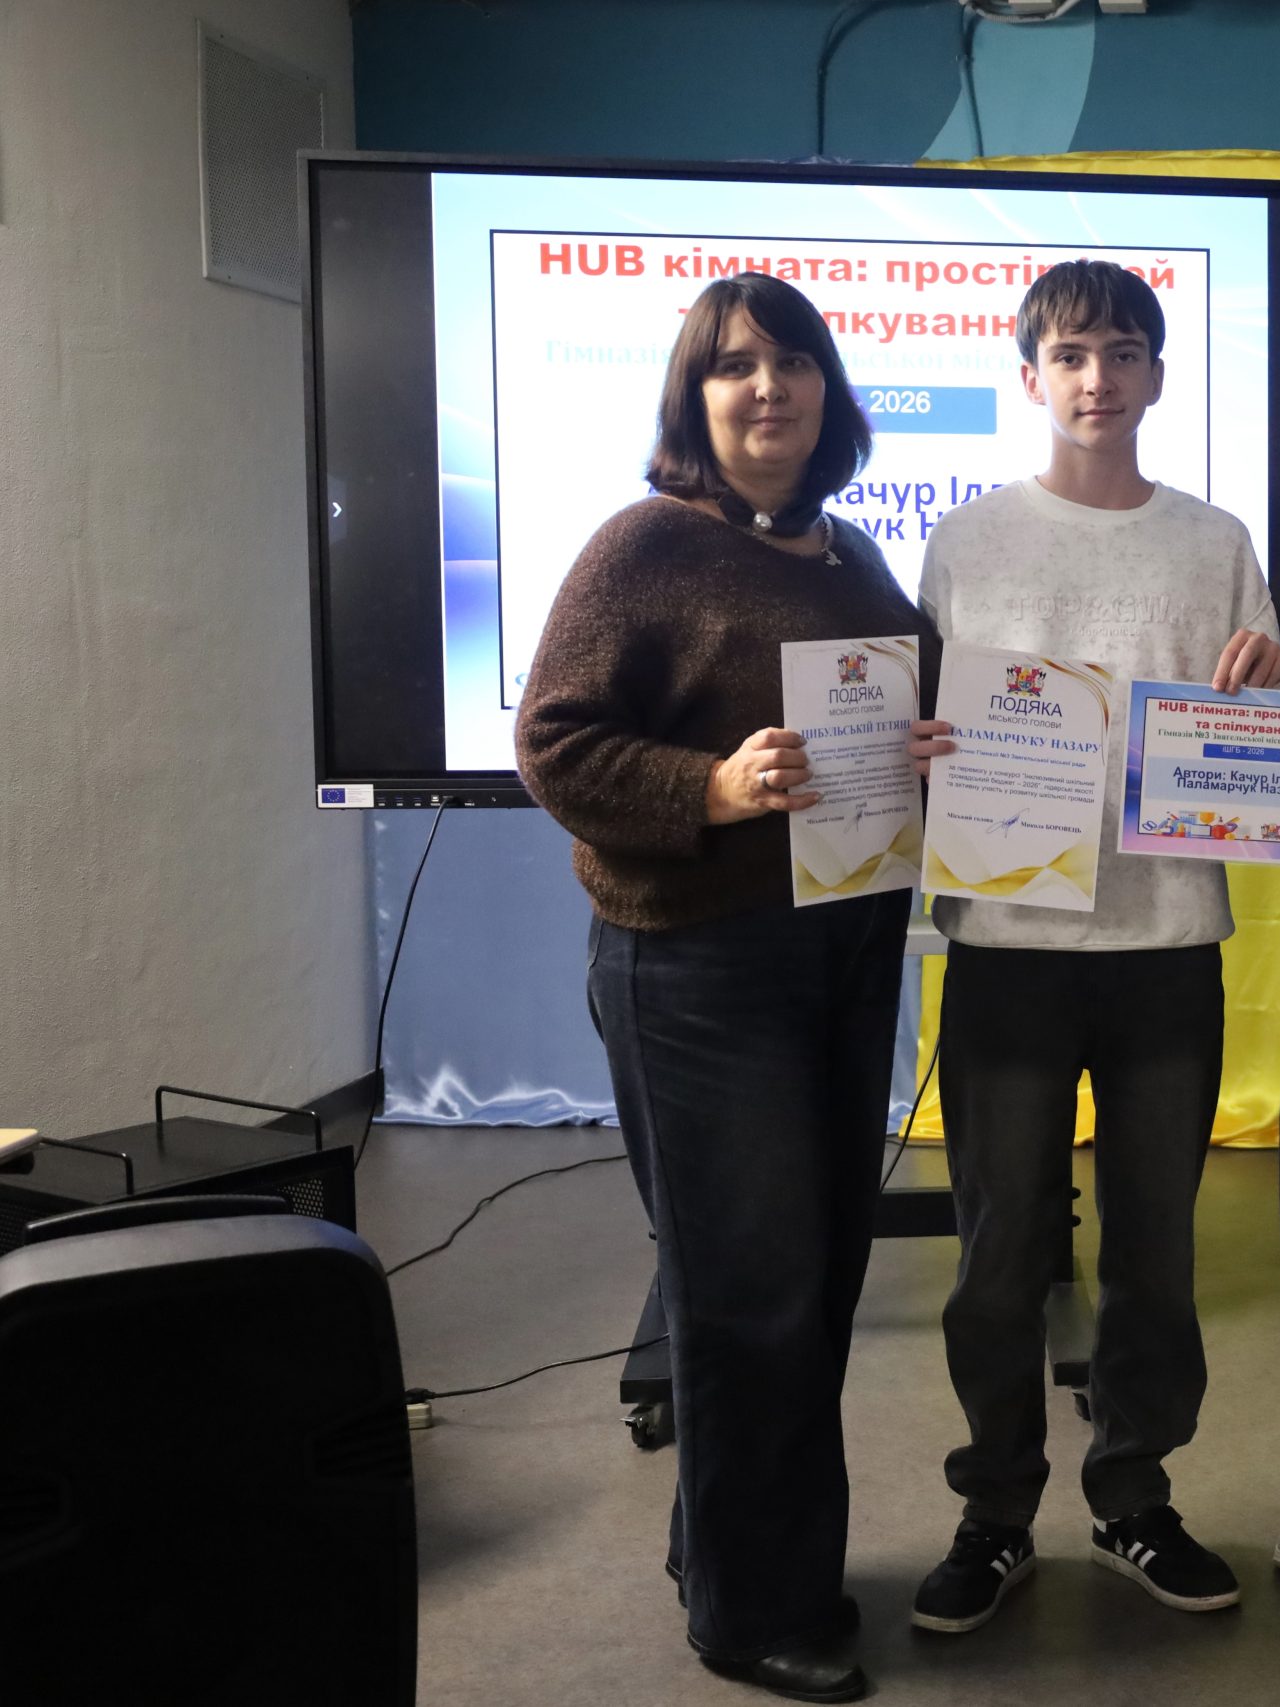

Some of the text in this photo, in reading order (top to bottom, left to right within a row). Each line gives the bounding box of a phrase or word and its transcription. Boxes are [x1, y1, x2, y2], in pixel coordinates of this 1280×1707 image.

[540, 243, 645, 276] HUB
[886, 256, 1053, 291] прості
[869, 390, 930, 413] 2026
[829, 686, 884, 704] ПОДЯКА
[829, 705, 884, 716] МІСЬКОГО ГОЛОВИ
[991, 695, 1063, 717] ПОДЯКА
[1158, 701, 1188, 713] HUB
[1192, 704, 1249, 718] кімната:
[988, 714, 1062, 729] МІСЬКОГО ГОЛОВИ
[1196, 720, 1210, 729] та
[1158, 729, 1193, 738] Гімназія
[1194, 731, 1210, 739] №3
[1051, 739, 1101, 753] НАЗАРУ
[1247, 747, 1265, 756] 2026
[1173, 766, 1226, 781] Автори:
[1230, 770, 1268, 788] Качур
[1177, 777, 1256, 795] Паламарчук
